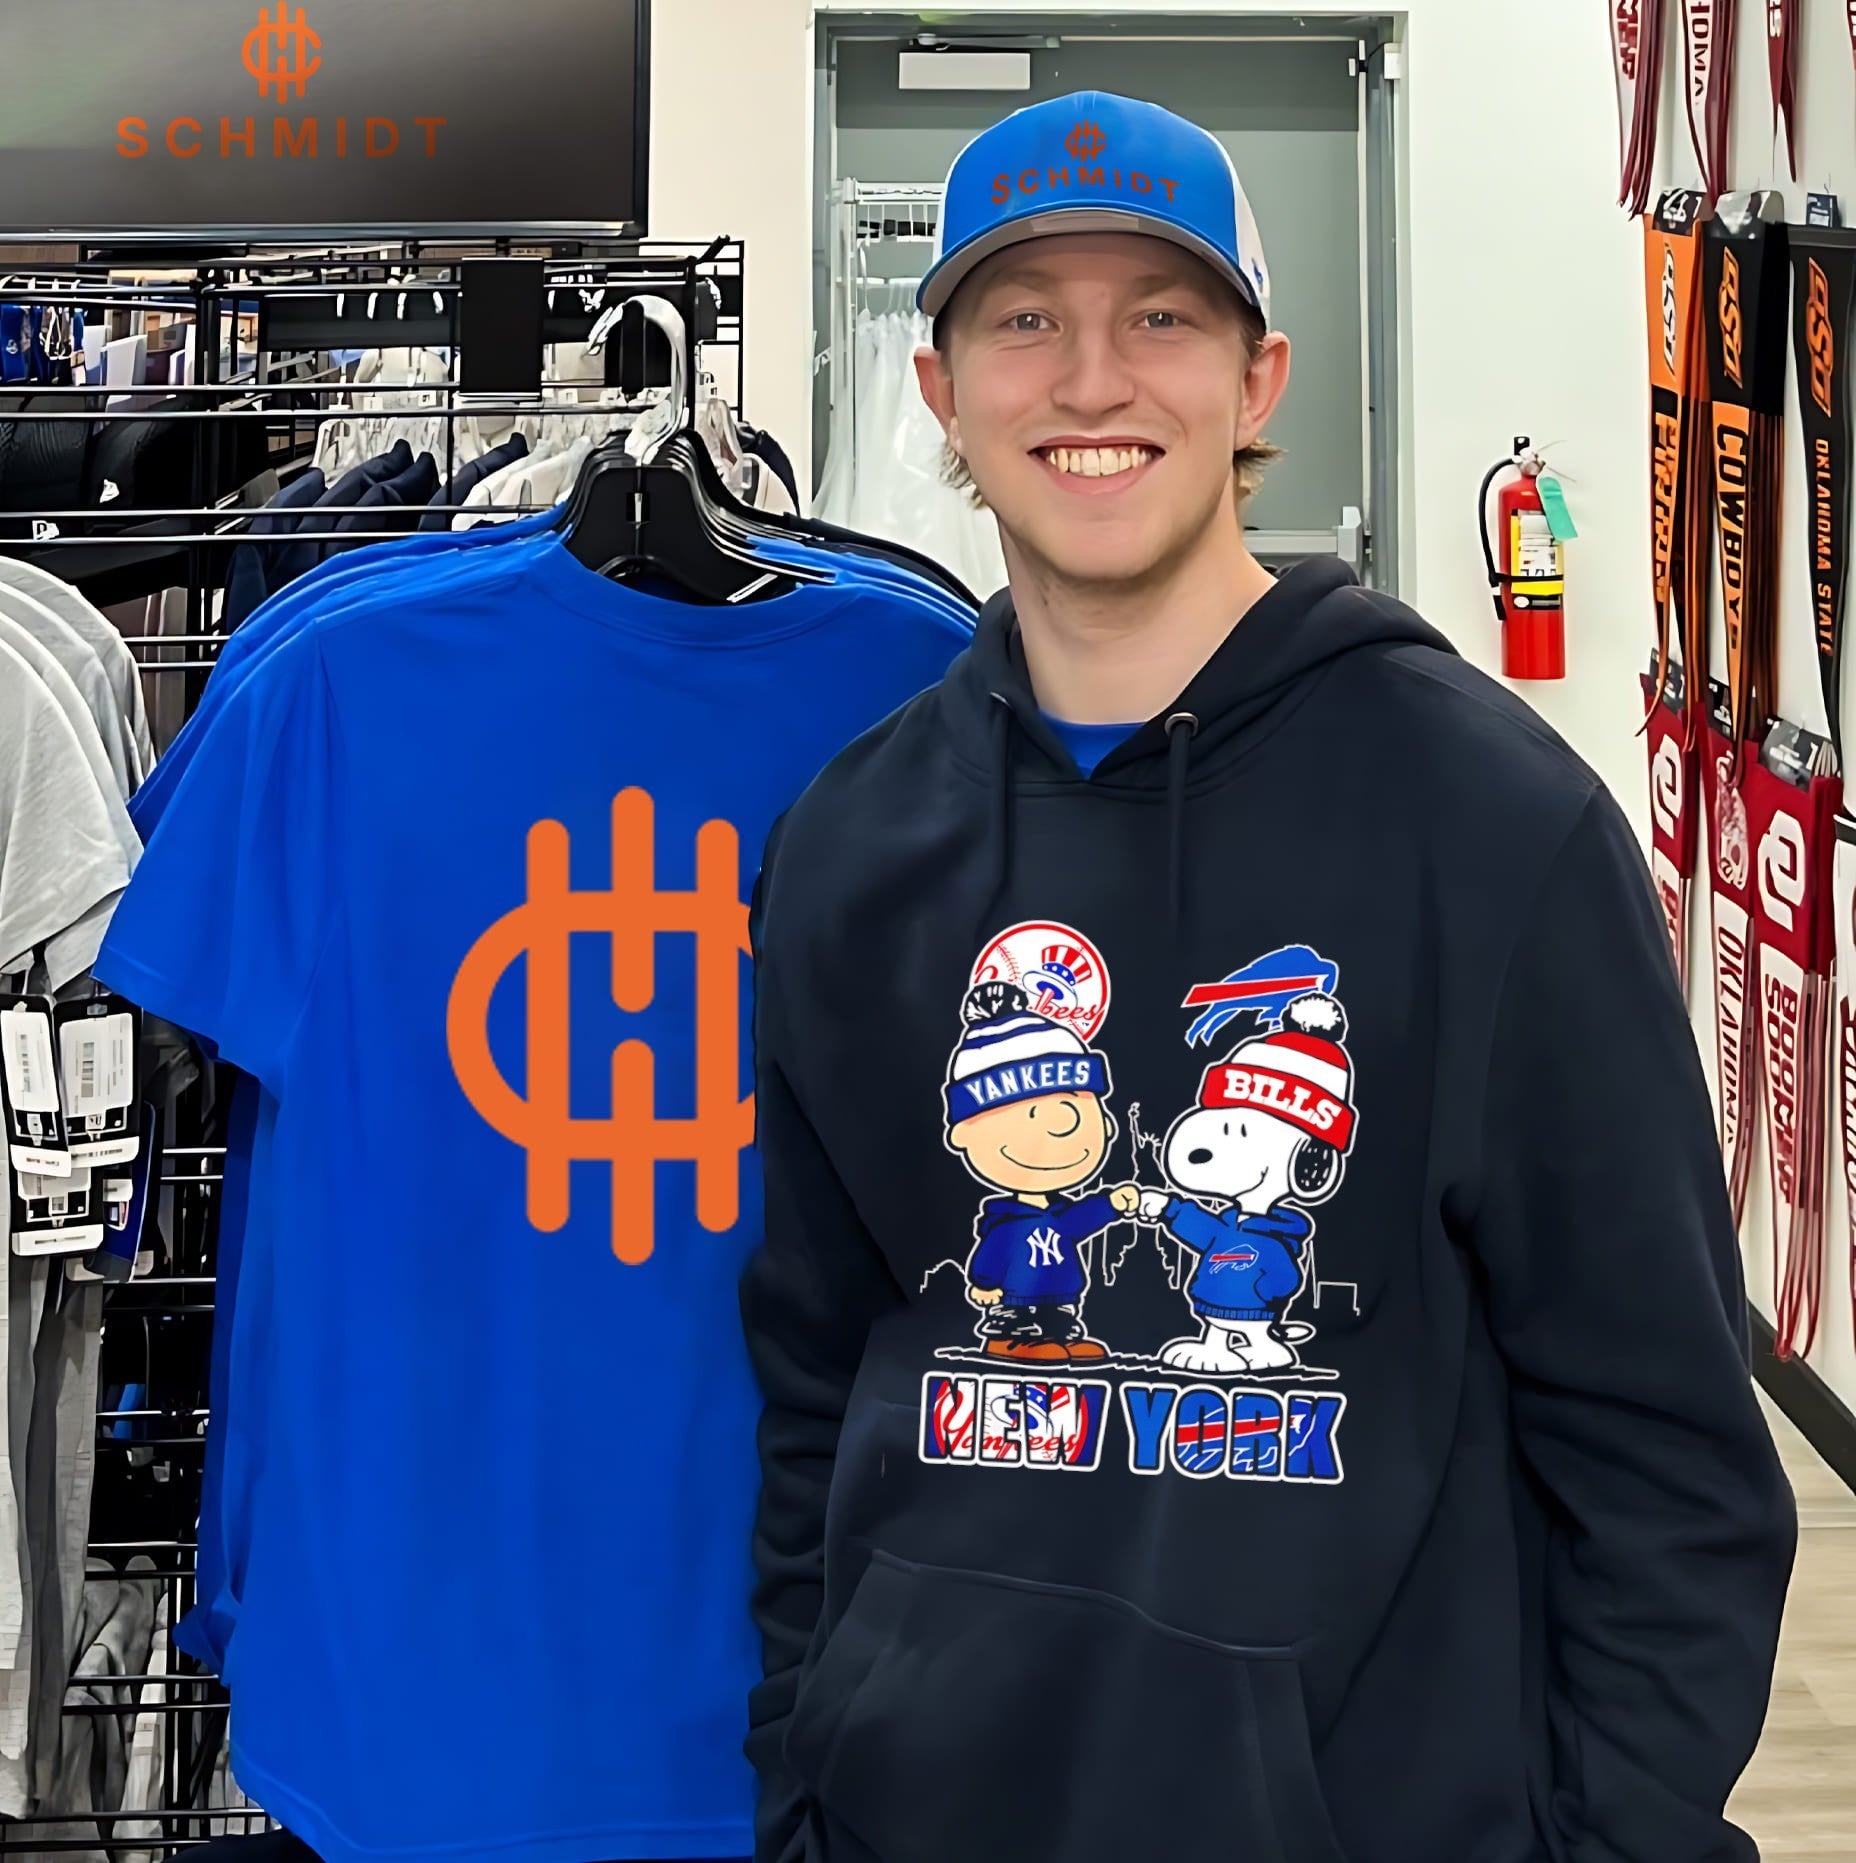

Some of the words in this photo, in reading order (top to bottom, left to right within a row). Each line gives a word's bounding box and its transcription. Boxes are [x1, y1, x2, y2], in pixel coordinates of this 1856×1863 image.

[115, 117, 448, 159] SCHMIDT
[991, 166, 1179, 205] SCHMIDT
[1815, 438, 1832, 570] OKLAHOMA
[966, 1060, 1091, 1106] YANKEES
[1223, 1068, 1342, 1131] BILLS
[920, 1372, 1112, 1472] NEW
[1119, 1381, 1347, 1485] YORK
